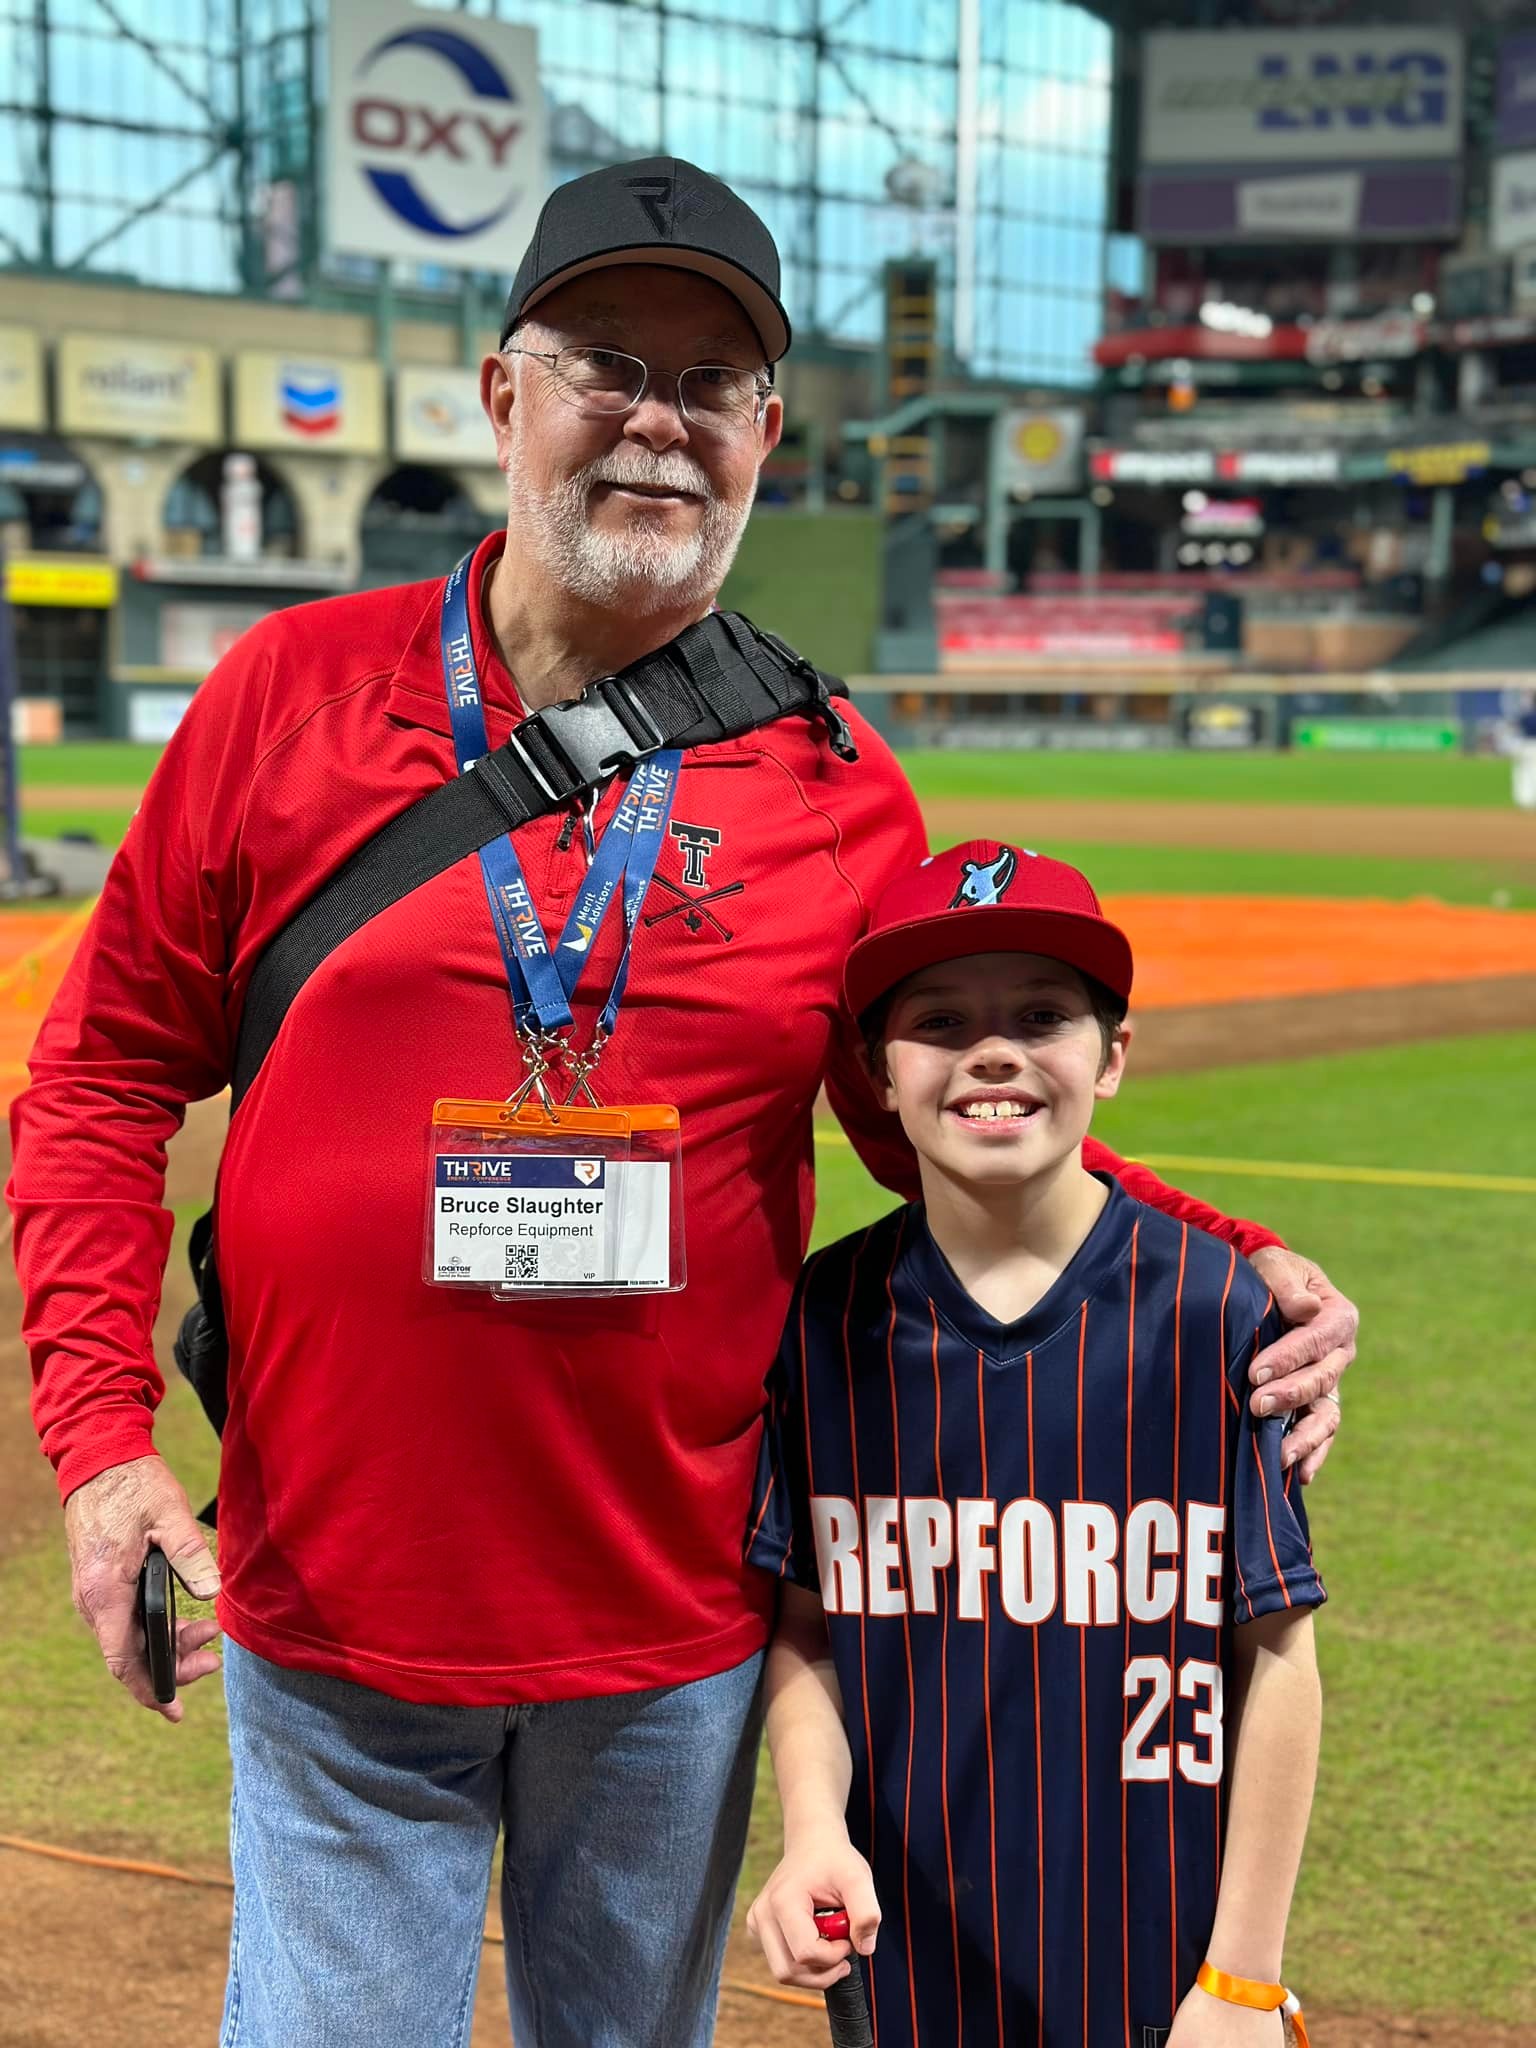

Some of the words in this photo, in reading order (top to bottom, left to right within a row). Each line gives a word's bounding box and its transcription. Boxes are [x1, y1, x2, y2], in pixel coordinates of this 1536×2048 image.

[353, 99, 521, 169] OXY
[451, 633, 478, 707] THRIVE
[637, 764, 668, 833] THRIVE
[504, 878, 546, 958] THRIVE
[577, 892, 596, 922] Merit
[588, 880, 613, 925] Advisors
[443, 1161, 512, 1177] THRIVE
[441, 1197, 500, 1213] Bruce
[506, 1197, 603, 1217] Slaughter
[450, 1223, 513, 1240] Repforce
[518, 1224, 593, 1239] Equipment
[809, 1494, 1227, 1628] REPFORCE
[1120, 1655, 1224, 1786] 23
